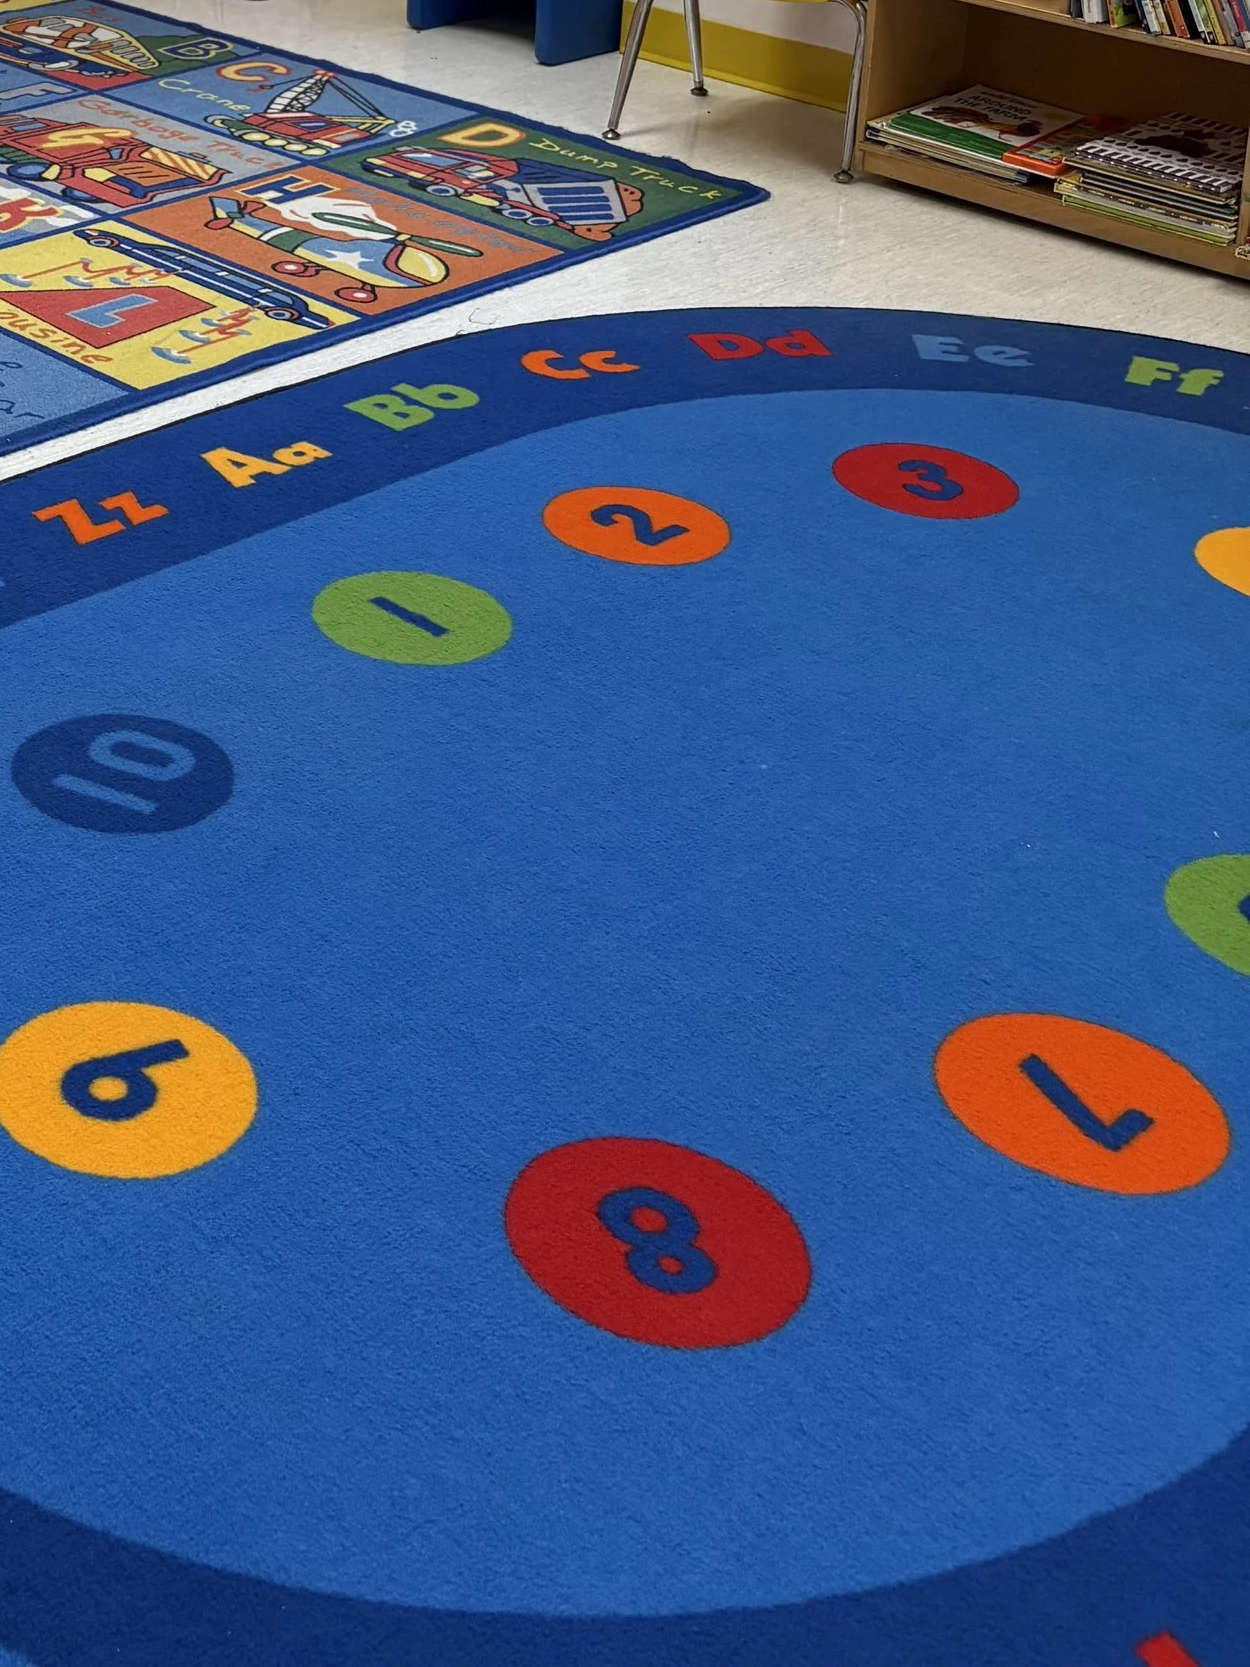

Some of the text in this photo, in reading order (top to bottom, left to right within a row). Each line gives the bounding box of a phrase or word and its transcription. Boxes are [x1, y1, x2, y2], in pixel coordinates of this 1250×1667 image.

[158, 36, 236, 60] B
[214, 61, 292, 82] C
[157, 78, 252, 113] Crane
[953, 97, 982, 108] THE
[969, 94, 1032, 114] AROUND
[77, 98, 286, 169] Garbage Truck
[437, 119, 527, 148] D
[233, 174, 341, 205] H
[528, 137, 728, 201] Dump Truck
[65, 293, 159, 328] L
[519, 348, 641, 381] Cc
[686, 329, 835, 362] Dd
[911, 333, 1036, 368] Ee
[1125, 355, 1226, 397] Ff
[342, 376, 483, 434] Bb
[200, 440, 334, 490] Aa
[897, 459, 964, 502] 3
[31, 488, 170, 545] Zz
[590, 504, 690, 547] 2
[366, 594, 452, 638] 1
[51, 728, 197, 812] 10
[1017, 1052, 1156, 1153] 7
[595, 1184, 721, 1295] 8
